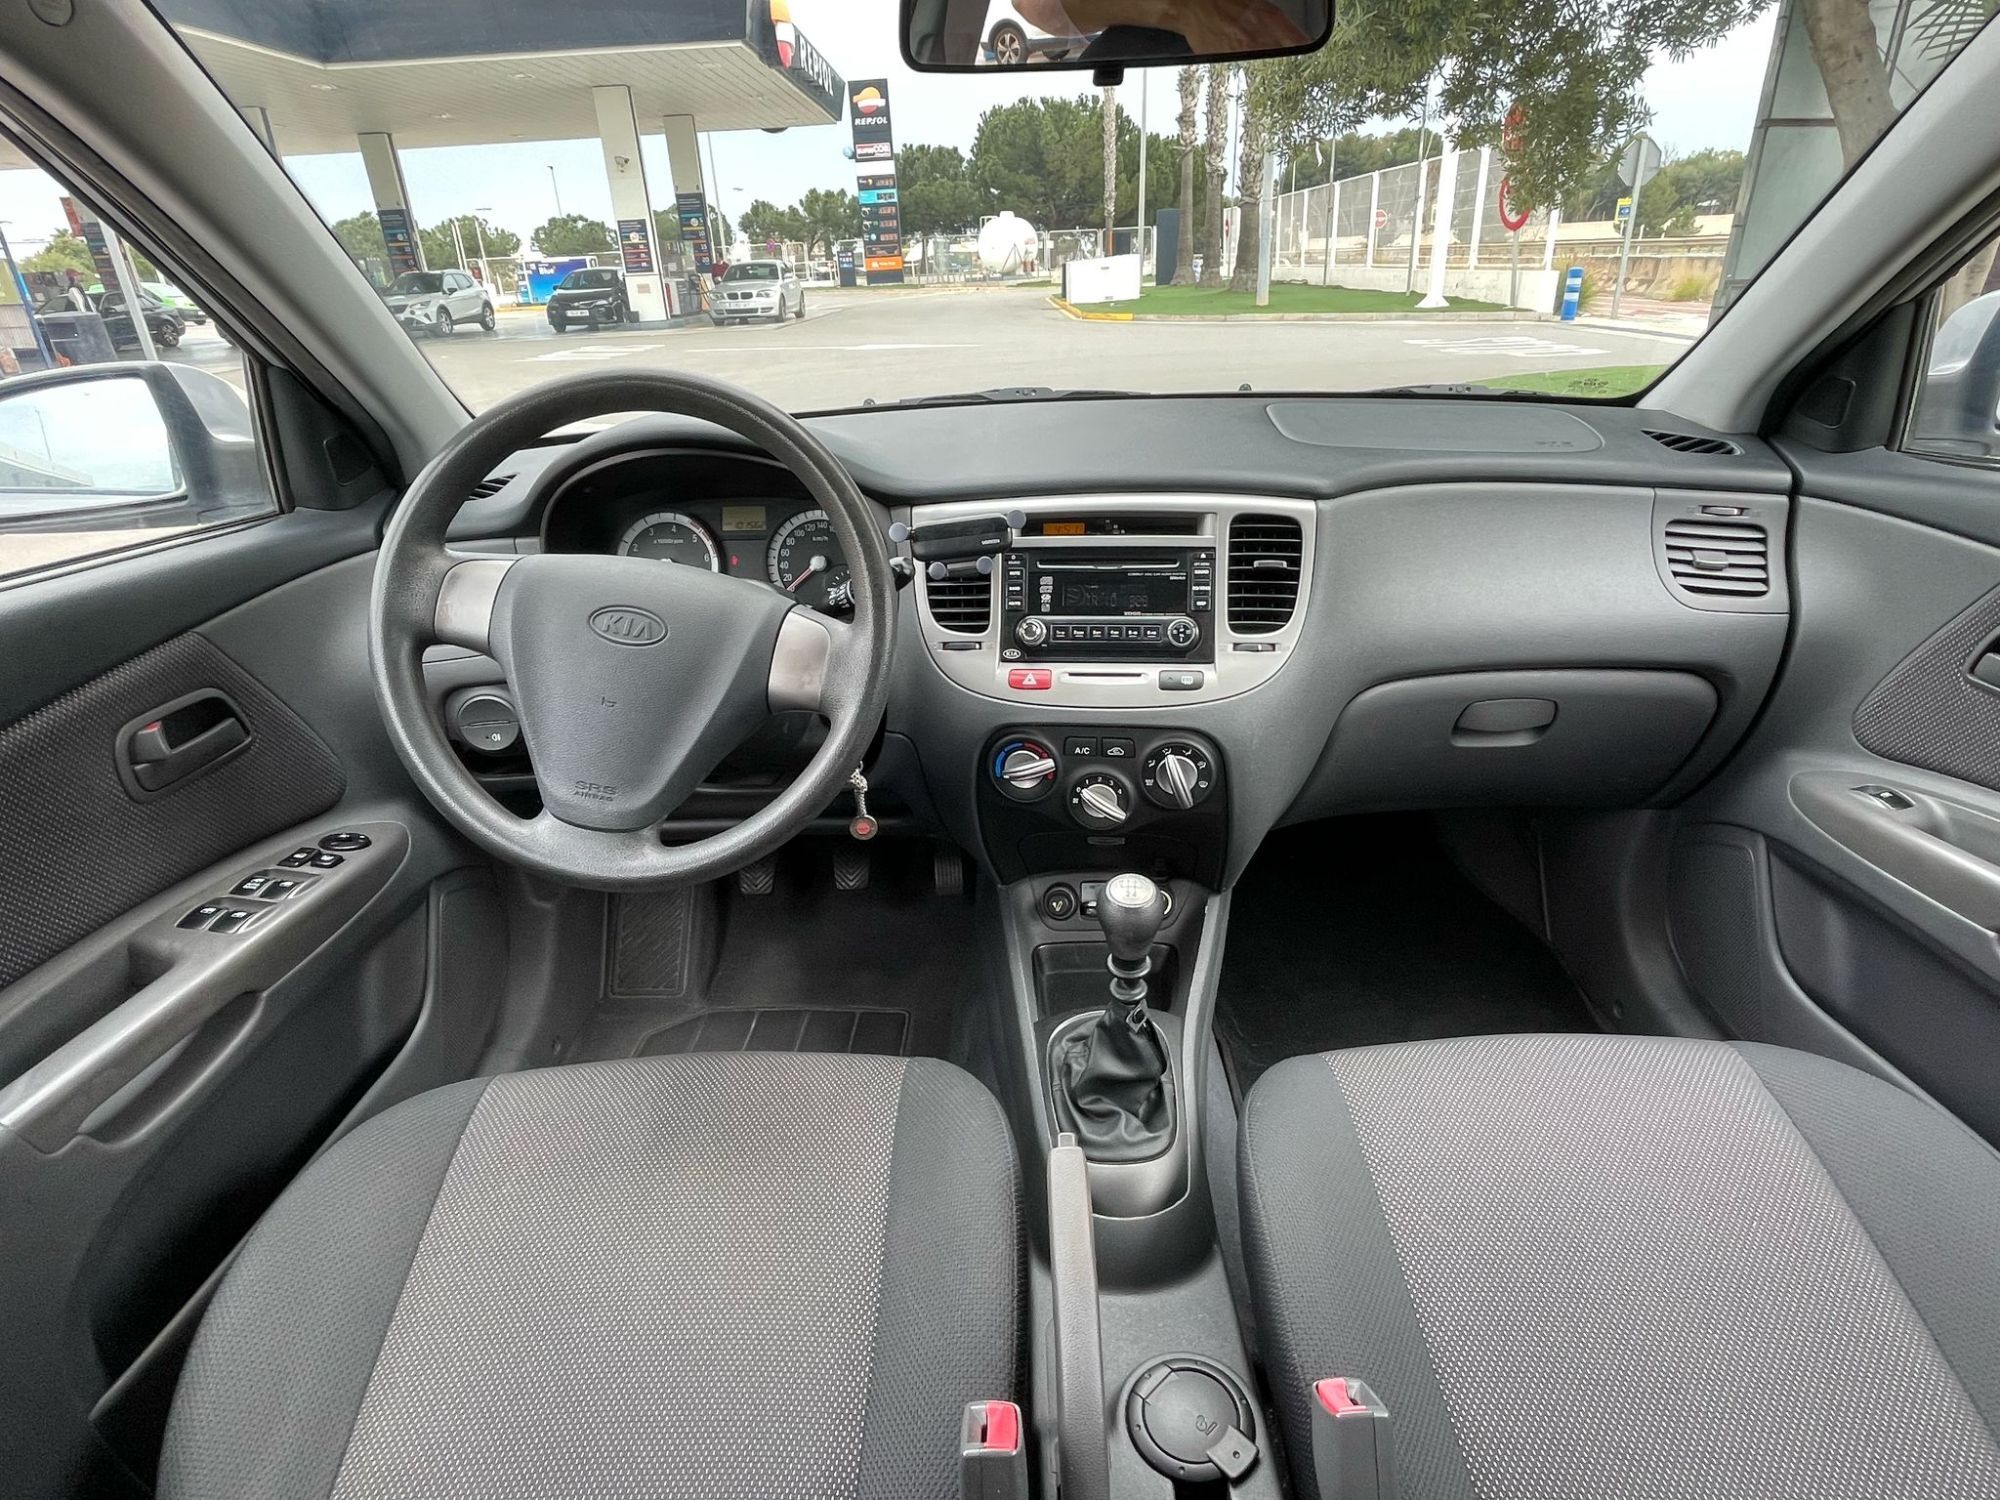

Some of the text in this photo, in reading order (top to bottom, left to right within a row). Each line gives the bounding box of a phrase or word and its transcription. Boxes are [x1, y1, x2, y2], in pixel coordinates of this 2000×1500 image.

[799, 33, 834, 96] REPSOL
[854, 116, 888, 126] REPSOL
[671, 524, 677, 533] 4
[804, 523, 816, 532] 120
[817, 521, 828, 529] 140
[648, 527, 654, 536] 3
[793, 529, 806, 537] 100
[691, 534, 698, 543] 5
[785, 536, 796, 546] 80
[632, 543, 639, 552] 2
[703, 552, 710, 562] 6
[780, 548, 790, 557] 60
[779, 560, 789, 569] 40
[782, 573, 793, 582] 20
[600, 614, 652, 641] KIA
[1074, 746, 1091, 755] A/C
[575, 780, 616, 796] SRS
